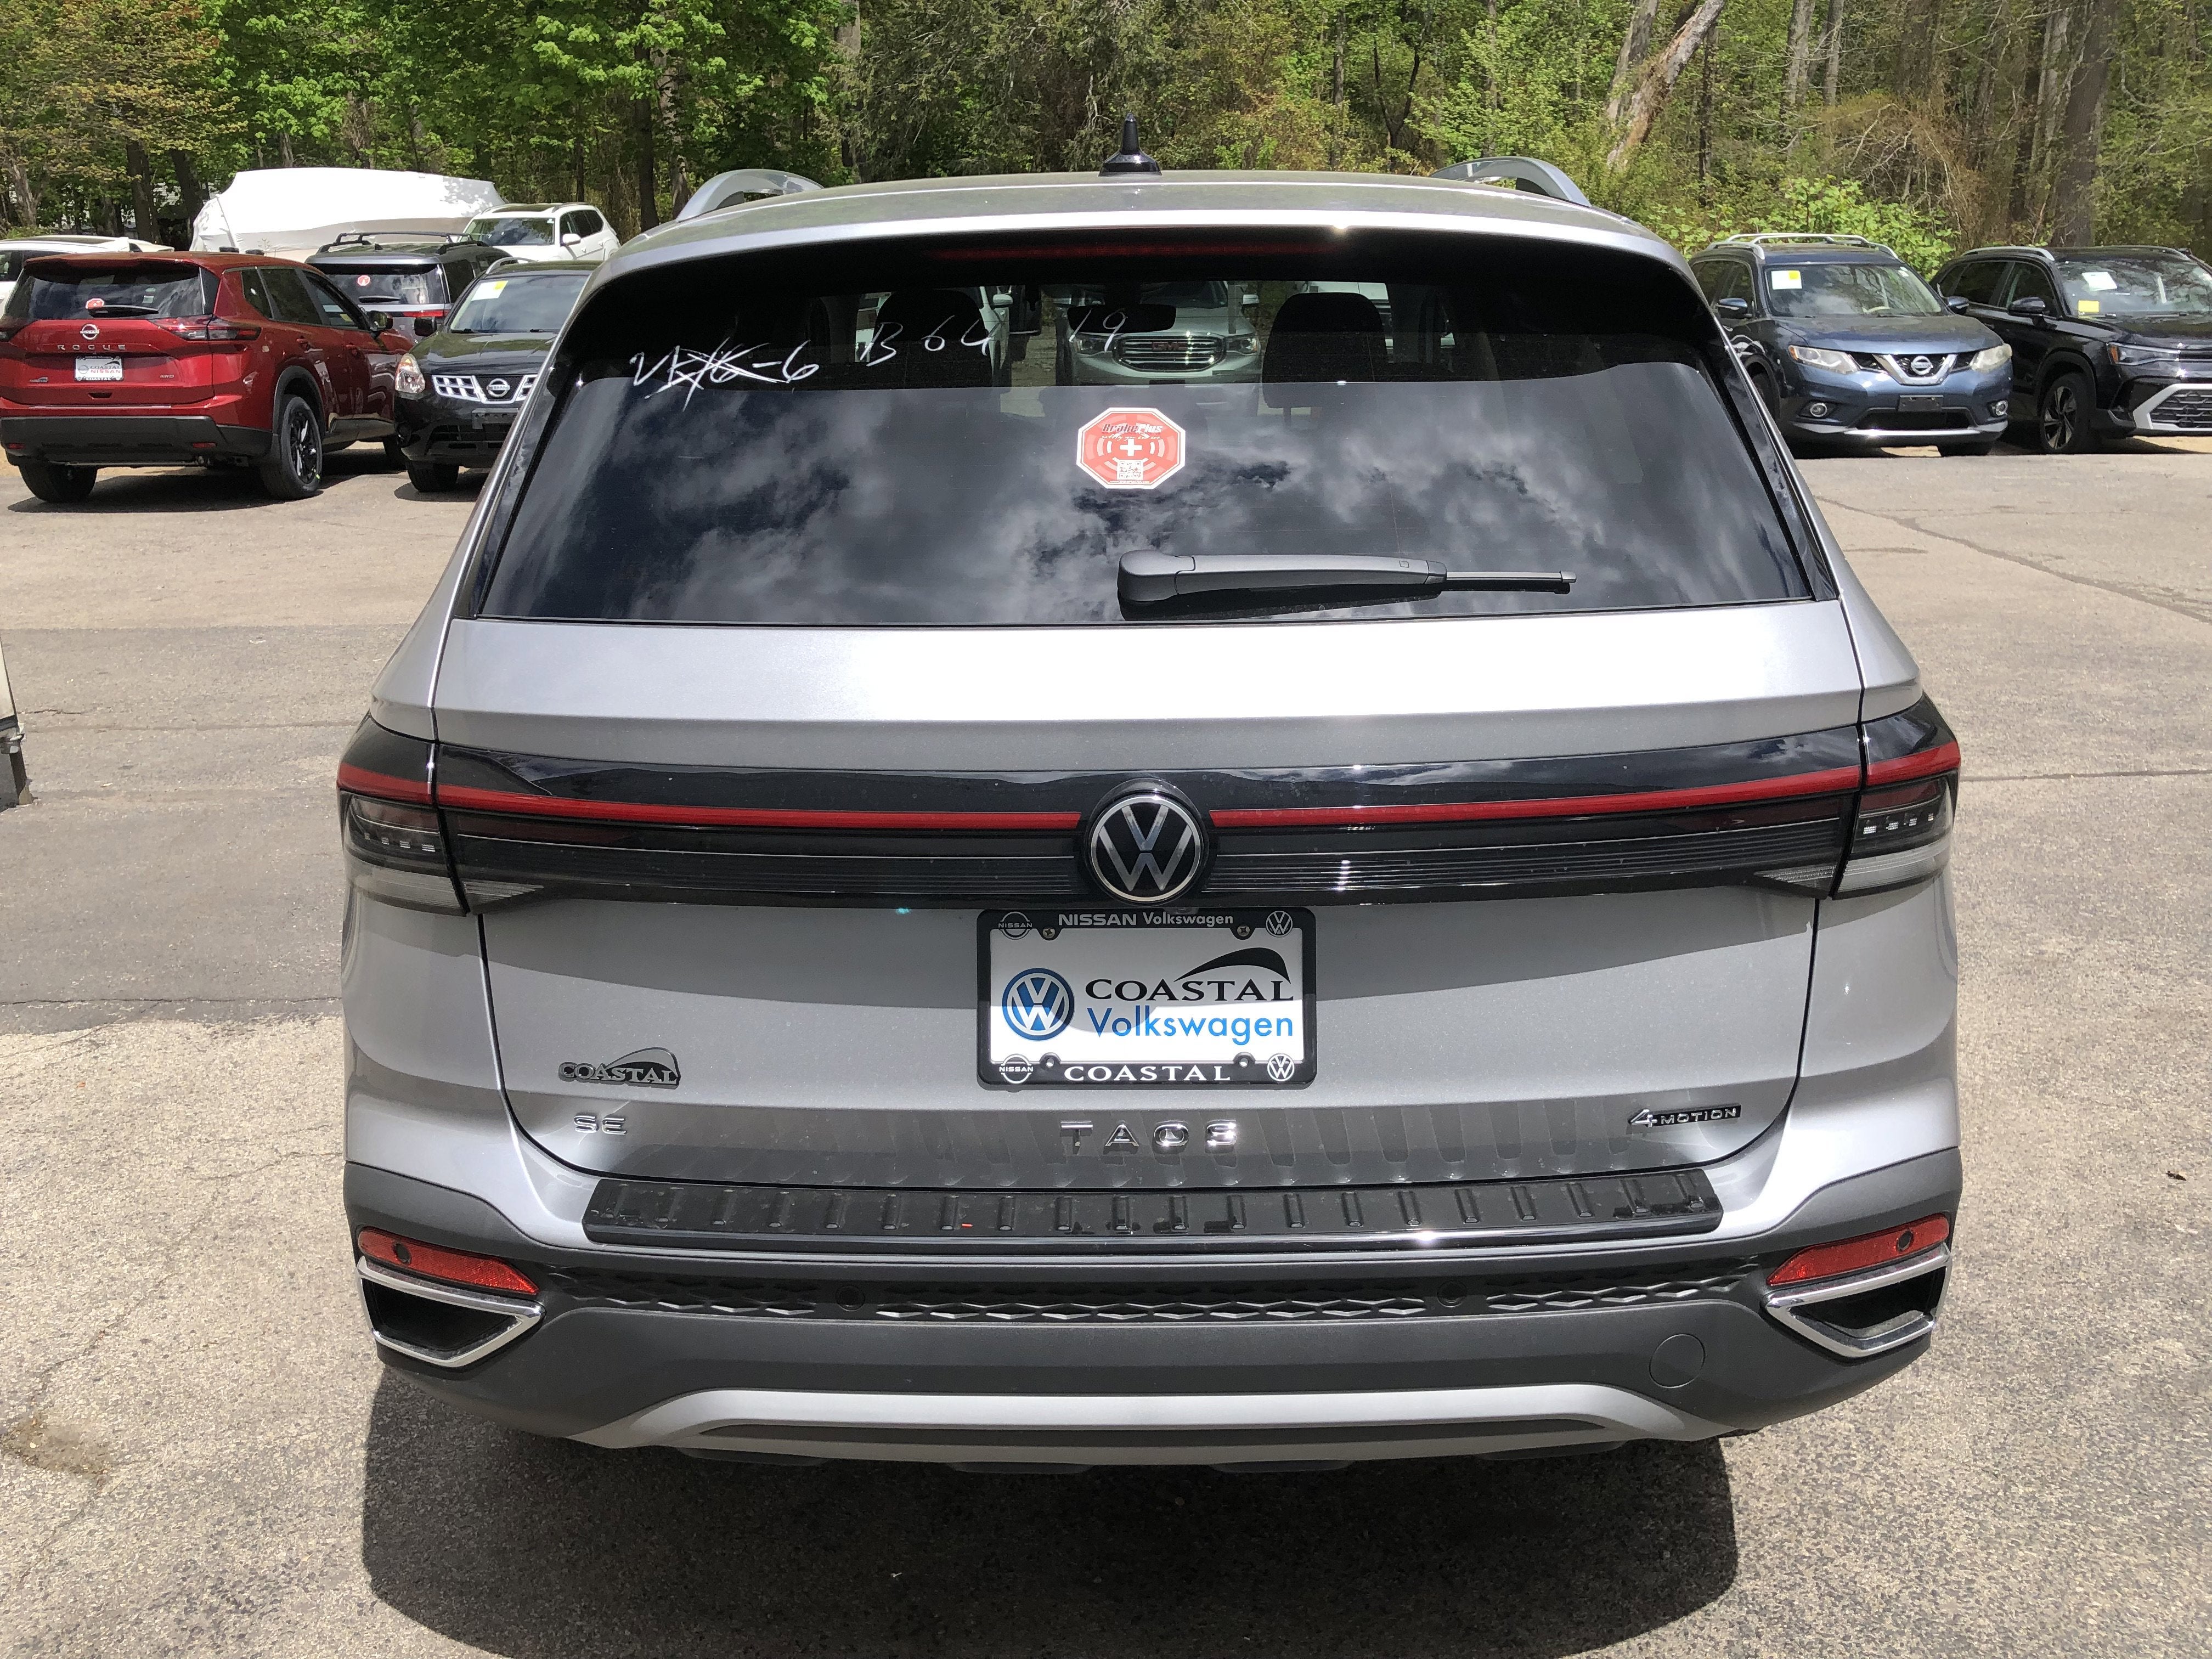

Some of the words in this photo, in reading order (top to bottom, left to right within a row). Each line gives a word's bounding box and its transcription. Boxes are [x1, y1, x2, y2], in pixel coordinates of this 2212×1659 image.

[1058, 913, 1137, 926] NISSAN
[1143, 912, 1233, 926] Volkswagen
[1086, 979, 1294, 1002] COASTAL
[1087, 1005, 1293, 1045] Volkswagen
[559, 1062, 678, 1085] COASTAL
[1064, 1066, 1230, 1082] COASTAL
[574, 1114, 627, 1136] SE
[1060, 1120, 1237, 1147] TAOS
